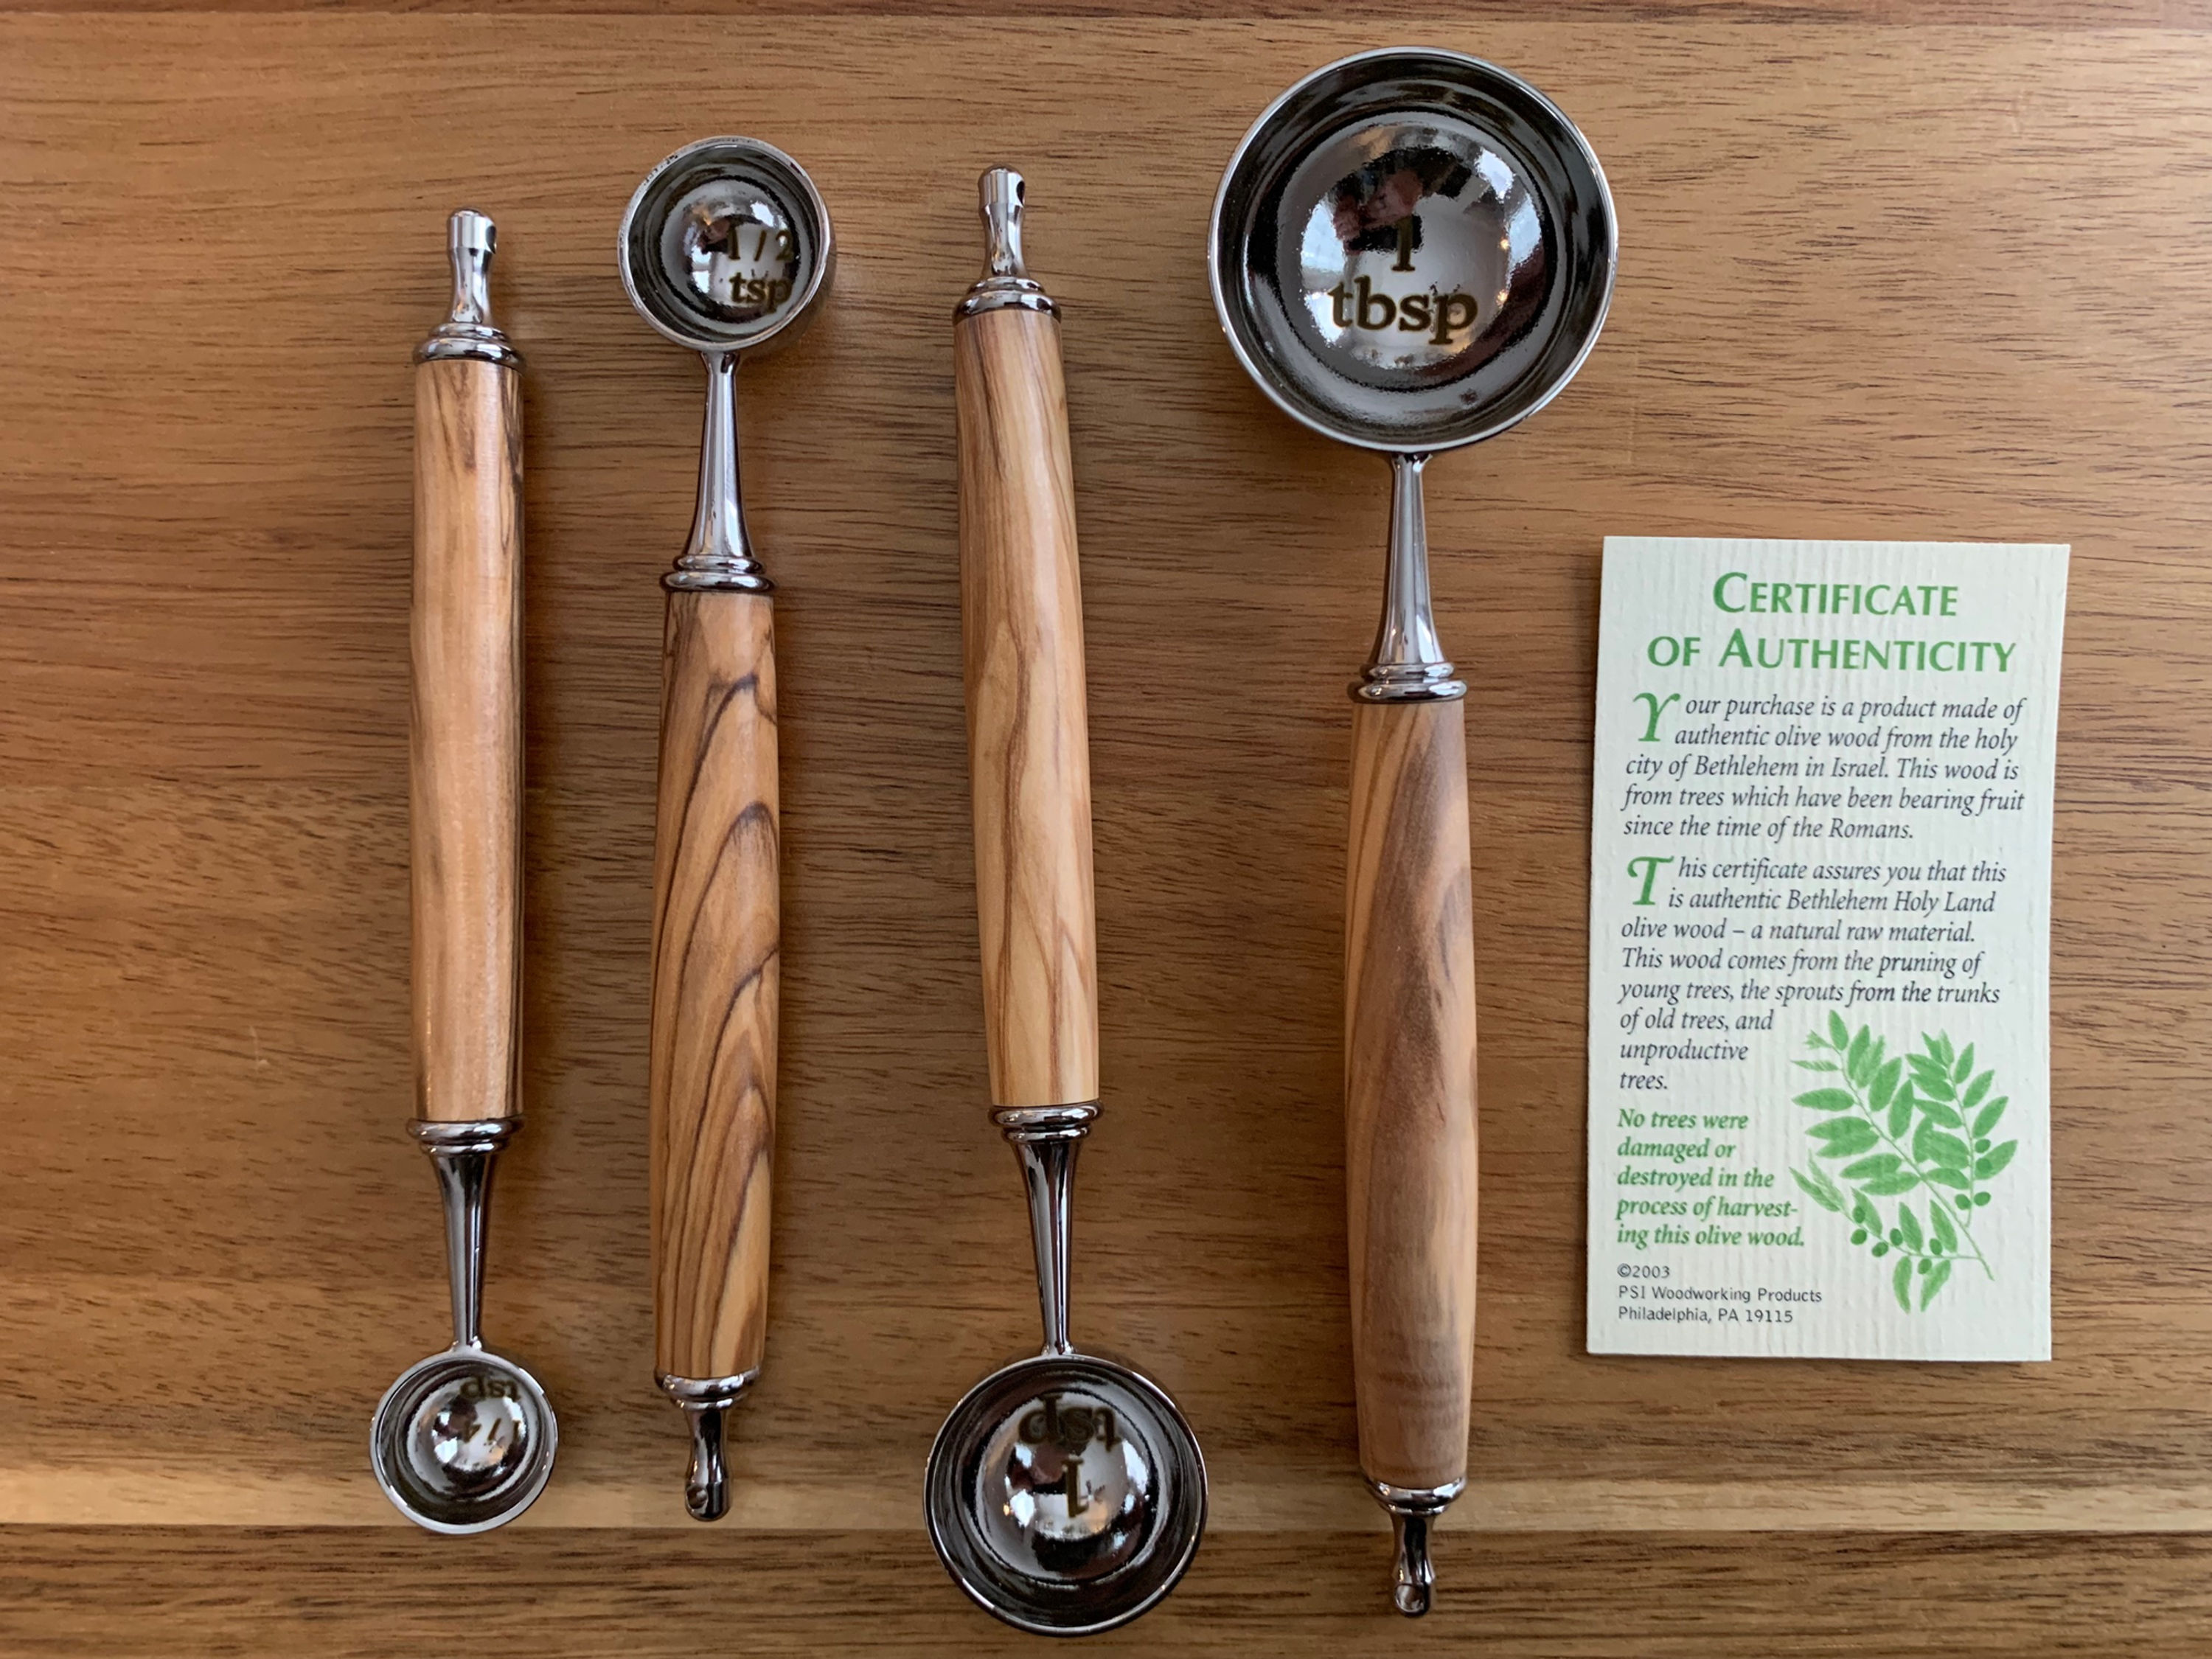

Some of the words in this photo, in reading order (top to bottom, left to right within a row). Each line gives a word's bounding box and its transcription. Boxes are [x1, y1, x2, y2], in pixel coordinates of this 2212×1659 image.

[1391, 215, 1416, 272] 1
[728, 271, 793, 313] tsp
[1328, 275, 1478, 345] tbsp
[1713, 572, 1958, 616] CERTIFICATE
[1648, 636, 1700, 667] OF
[1719, 628, 2016, 672] AUTHENTICITY
[1725, 695, 1815, 722] purchase
[1821, 698, 1836, 717] is
[1842, 703, 1854, 717] a
[1859, 698, 1936, 723] product
[1942, 698, 1997, 719] made
[2003, 697, 2027, 724] of
[1674, 724, 1769, 746] authentic
[1775, 727, 1820, 747] olive
[1829, 727, 1880, 748] wood
[1883, 728, 1932, 754] from
[1939, 728, 1969, 749] the
[1975, 728, 2018, 754] holy
[1626, 755, 1663, 780] city
[1669, 754, 1692, 780] of
[1695, 755, 1799, 777] Bethlehem
[1806, 757, 1824, 777] in
[1831, 757, 1890, 778] Israel.
[1898, 757, 1938, 779] This
[1944, 759, 1997, 779] wood
[2003, 760, 2019, 779] is
[1620, 784, 1673, 811] from
[1680, 788, 1724, 807] trees
[1731, 786, 1789, 808] which
[1795, 787, 1840, 808] have
[1848, 788, 1893, 809] been
[1899, 790, 1973, 815] bearing
[1978, 790, 2025, 815] fruit
[1624, 815, 1674, 835] since
[1680, 815, 1709, 836] the
[1717, 817, 1762, 837] time
[1768, 815, 1790, 843] of
[1793, 817, 1821, 838] the
[1829, 818, 1914, 839] Romans.
[1713, 859, 1807, 884] certificate
[1813, 864, 1881, 880] assures
[1885, 866, 1921, 886] you
[1927, 861, 1966, 882] that
[1972, 861, 2006, 883] this
[1669, 889, 1683, 908] is
[1689, 889, 1781, 910] authentic
[1786, 889, 1888, 911] Bethlehem
[1893, 891, 1938, 917] Holy
[1944, 891, 1995, 913] Land
[1622, 918, 1667, 939] olive
[1674, 919, 1726, 939] wood
[1750, 925, 1763, 939] a
[1769, 919, 1840, 941] natural
[1846, 926, 1883, 941] raw
[1888, 922, 1976, 942] material.
[1623, 947, 1663, 968] This
[1670, 949, 1722, 969] wood
[1728, 954, 1786, 970] comes
[1787, 950, 1837, 976] from
[1844, 950, 1874, 972] the
[1877, 952, 1956, 978] pruning
[1962, 951, 1983, 978] of
[1618, 980, 1680, 1004] young
[1686, 981, 1734, 1002] trees,
[1741, 979, 1770, 1000] the
[1774, 983, 1843, 1006] sprouts
[1845, 981, 1895, 1007] from
[1902, 981, 1931, 1001] the
[1937, 983, 2000, 1004] trunks
[1620, 1008, 1643, 1034] of
[1645, 1009, 1674, 1030] old
[1681, 1012, 1729, 1032] trees,
[1736, 1009, 1773, 1031] and
[1620, 1040, 1748, 1065] unproductive
[1620, 1071, 1668, 1089] trees.
[1618, 1108, 1644, 1128] No
[1651, 1111, 1696, 1129] trees
[1701, 1114, 1748, 1130] were
[1618, 1137, 1708, 1164] damaged
[1714, 1144, 1736, 1158] or
[1618, 1166, 1713, 1192] destroyed
[1719, 1168, 1737, 1186] in
[1744, 1169, 1774, 1188] the
[1615, 1200, 1688, 1220] process
[1692, 1197, 1715, 1220] of
[1717, 1197, 1798, 1218] harvest-
[1618, 1225, 1649, 1250] ing
[1654, 1225, 1689, 1245] this
[1696, 1226, 1742, 1245] olive
[1747, 1226, 1805, 1247] wood.
[1618, 1286, 1646, 1300] PSI
[1652, 1287, 1750, 1304] Woodworking
[1757, 1287, 1822, 1302] Products
[1618, 1307, 1712, 1323] Philadelphia,
[1718, 1308, 1739, 1322] PA
[1745, 1309, 1793, 1323] 19115
